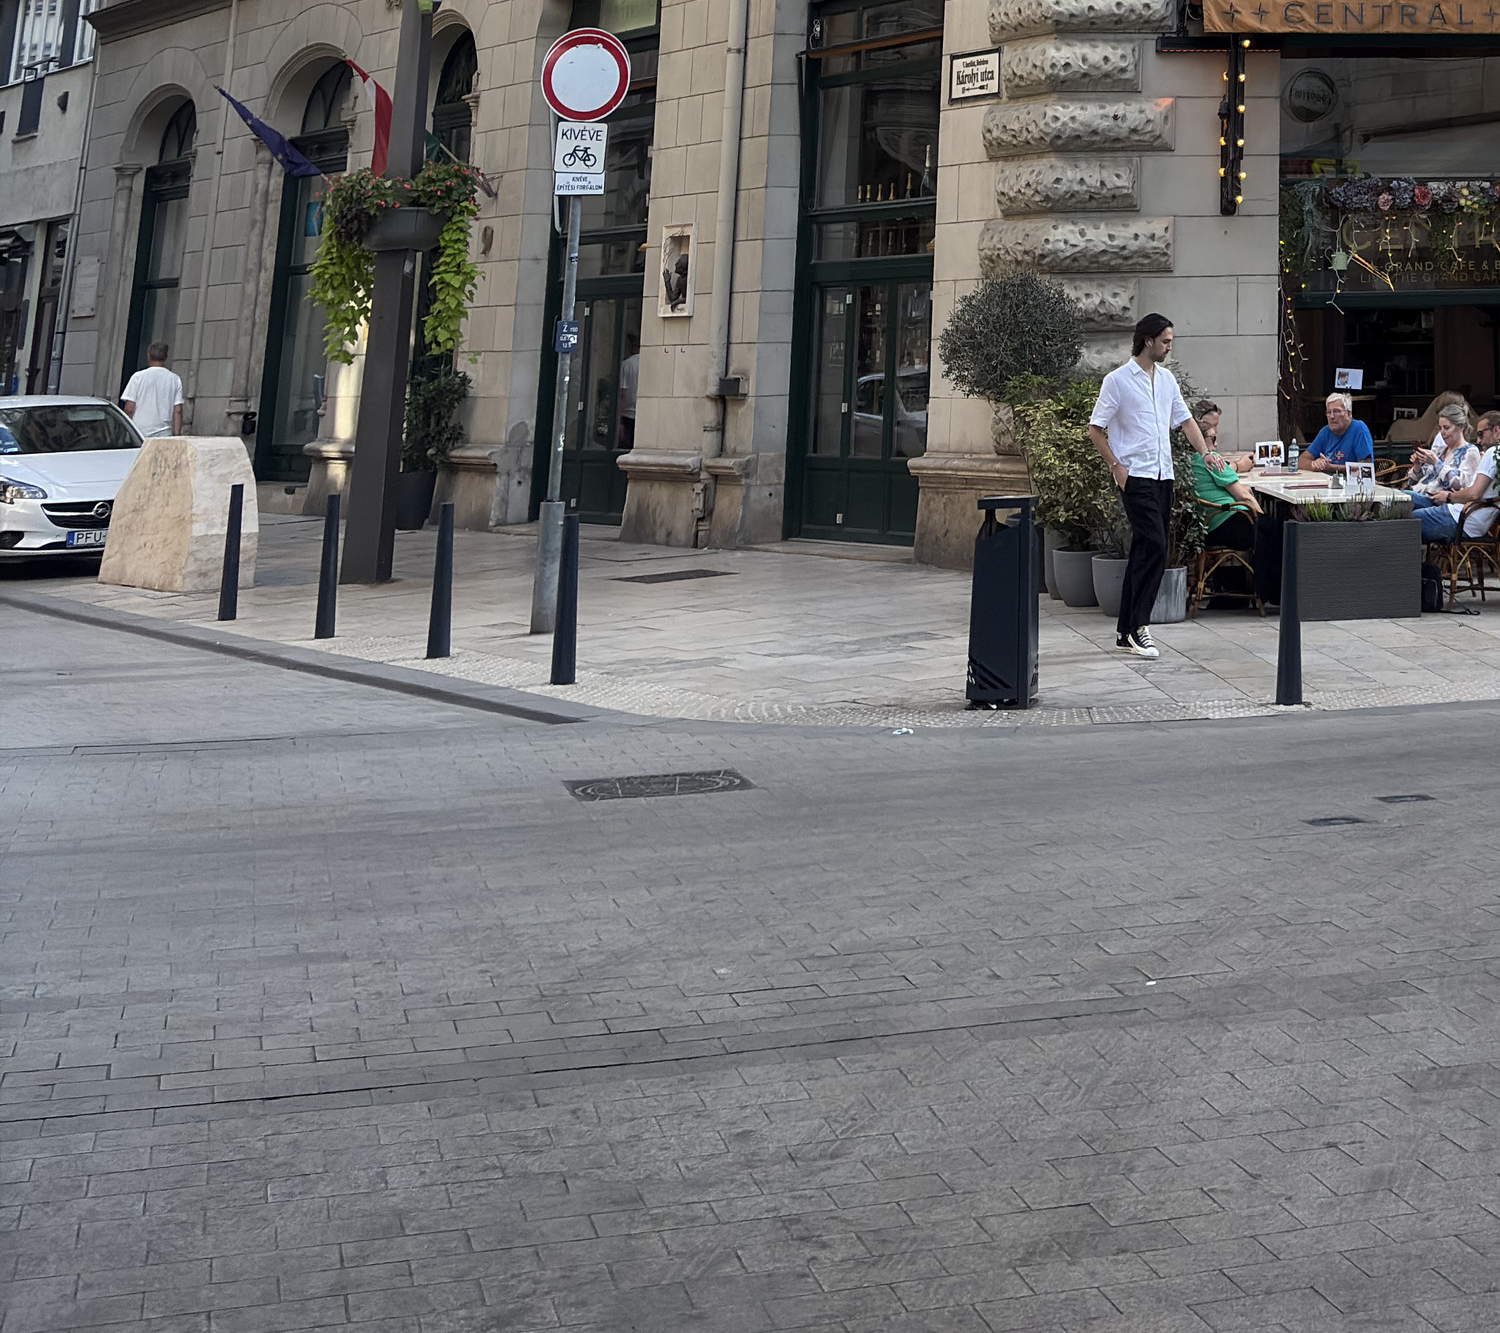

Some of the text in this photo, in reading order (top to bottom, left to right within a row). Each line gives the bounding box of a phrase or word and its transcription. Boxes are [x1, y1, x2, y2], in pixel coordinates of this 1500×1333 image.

[1283, 2, 1474, 26] CENTRAL
[957, 68, 994, 86] Károlyi utca
[561, 126, 603, 141] KIVÉVE
[1385, 261, 1434, 272] GRAND
[1481, 260, 1489, 270] &
[76, 531, 107, 543] PFU-
